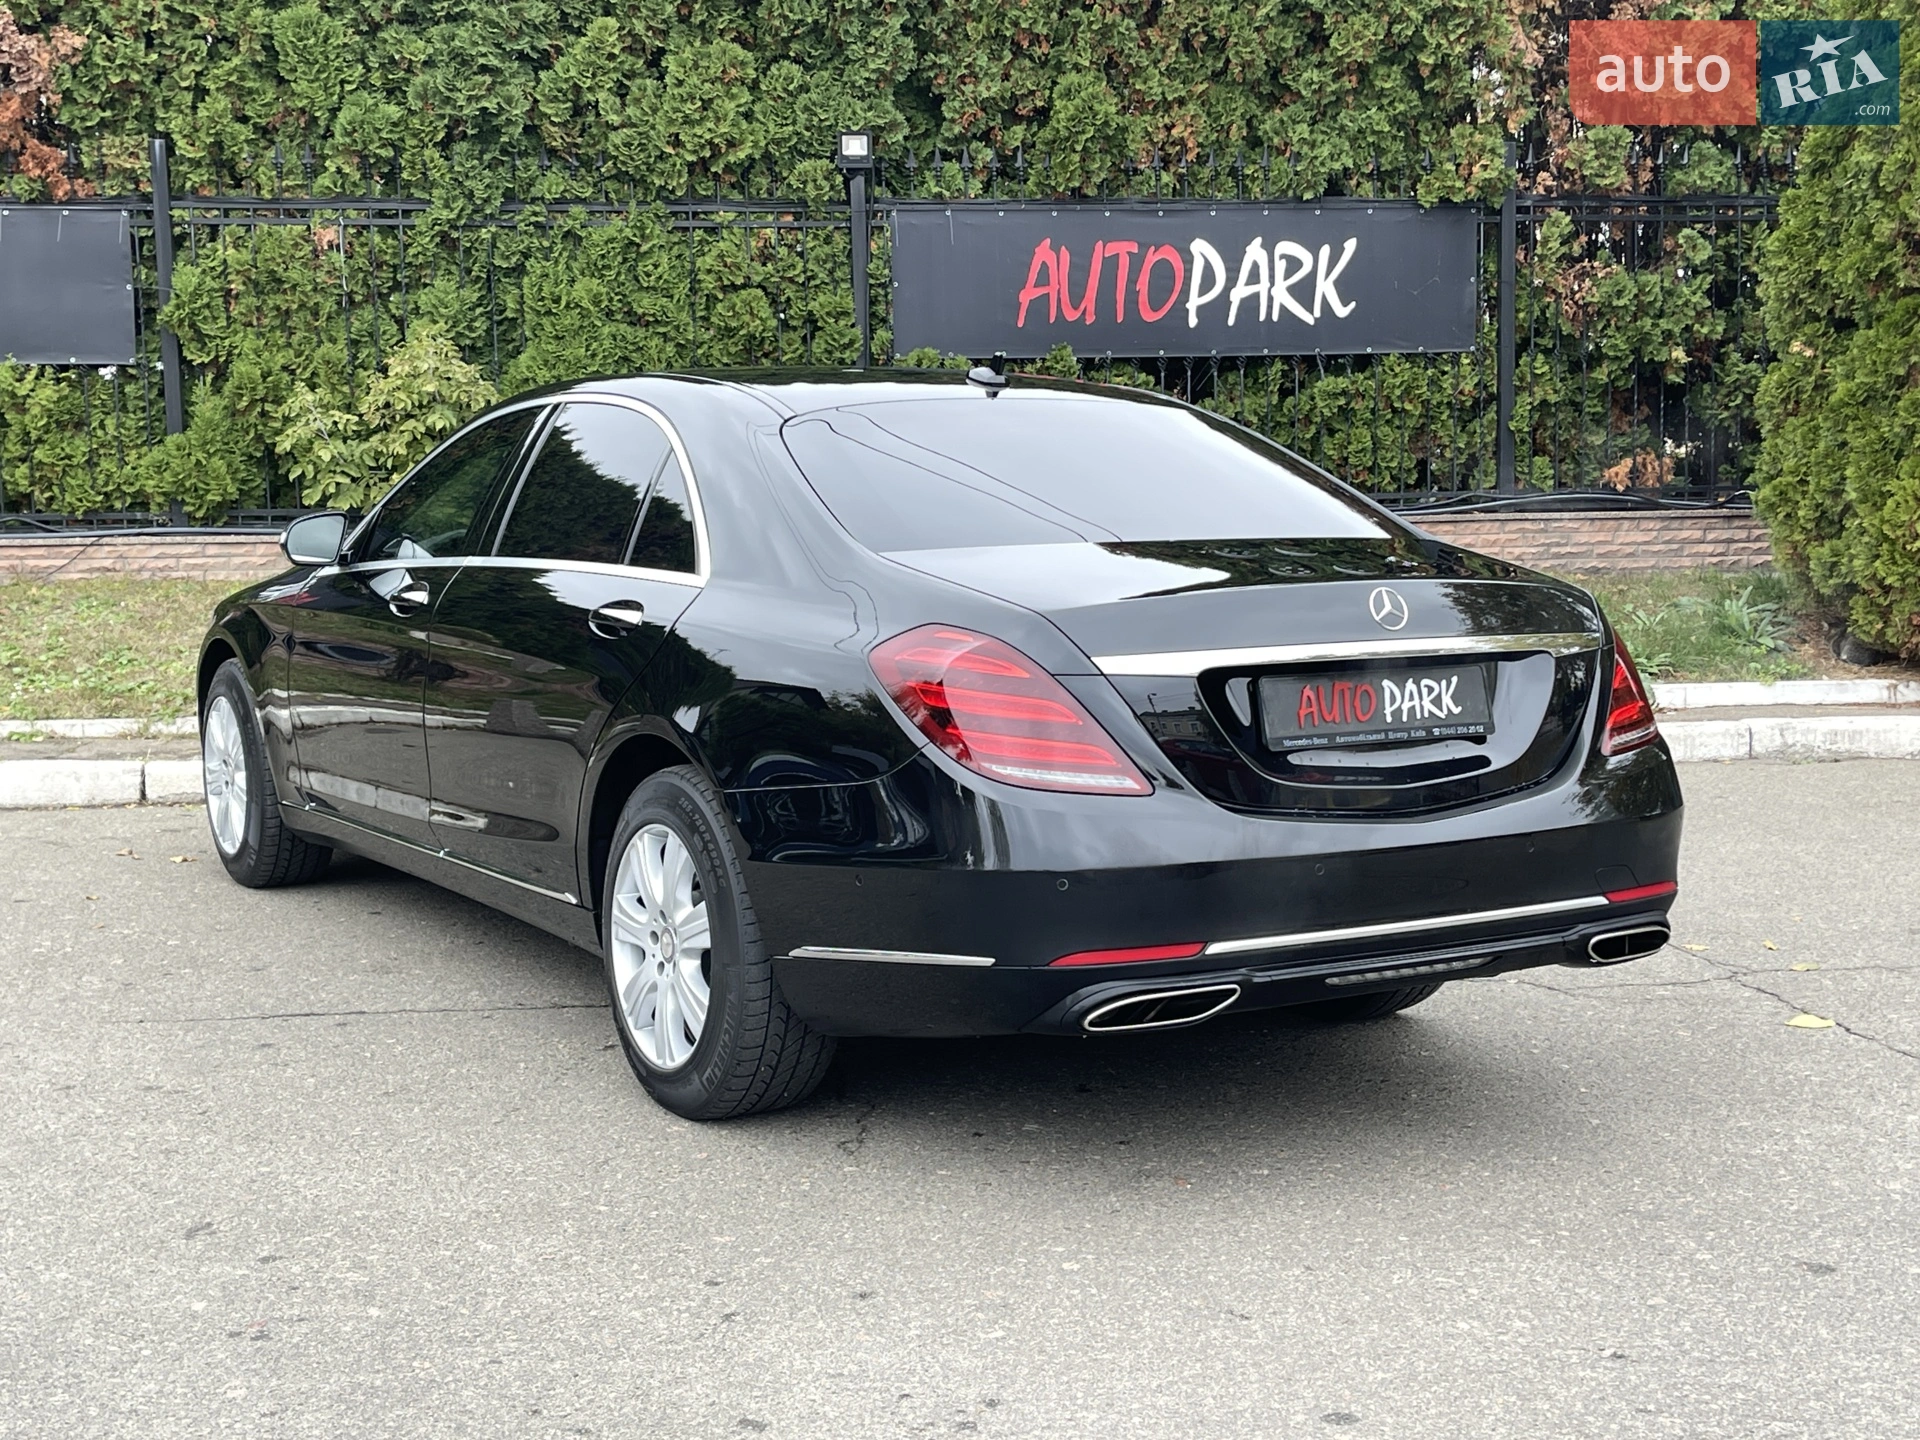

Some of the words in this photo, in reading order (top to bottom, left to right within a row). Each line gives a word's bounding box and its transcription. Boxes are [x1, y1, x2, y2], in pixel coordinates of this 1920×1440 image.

[1297, 681, 1378, 729] AUTO
[1381, 675, 1463, 724] PARK
[1283, 737, 1329, 748] Mercedes-Benz
